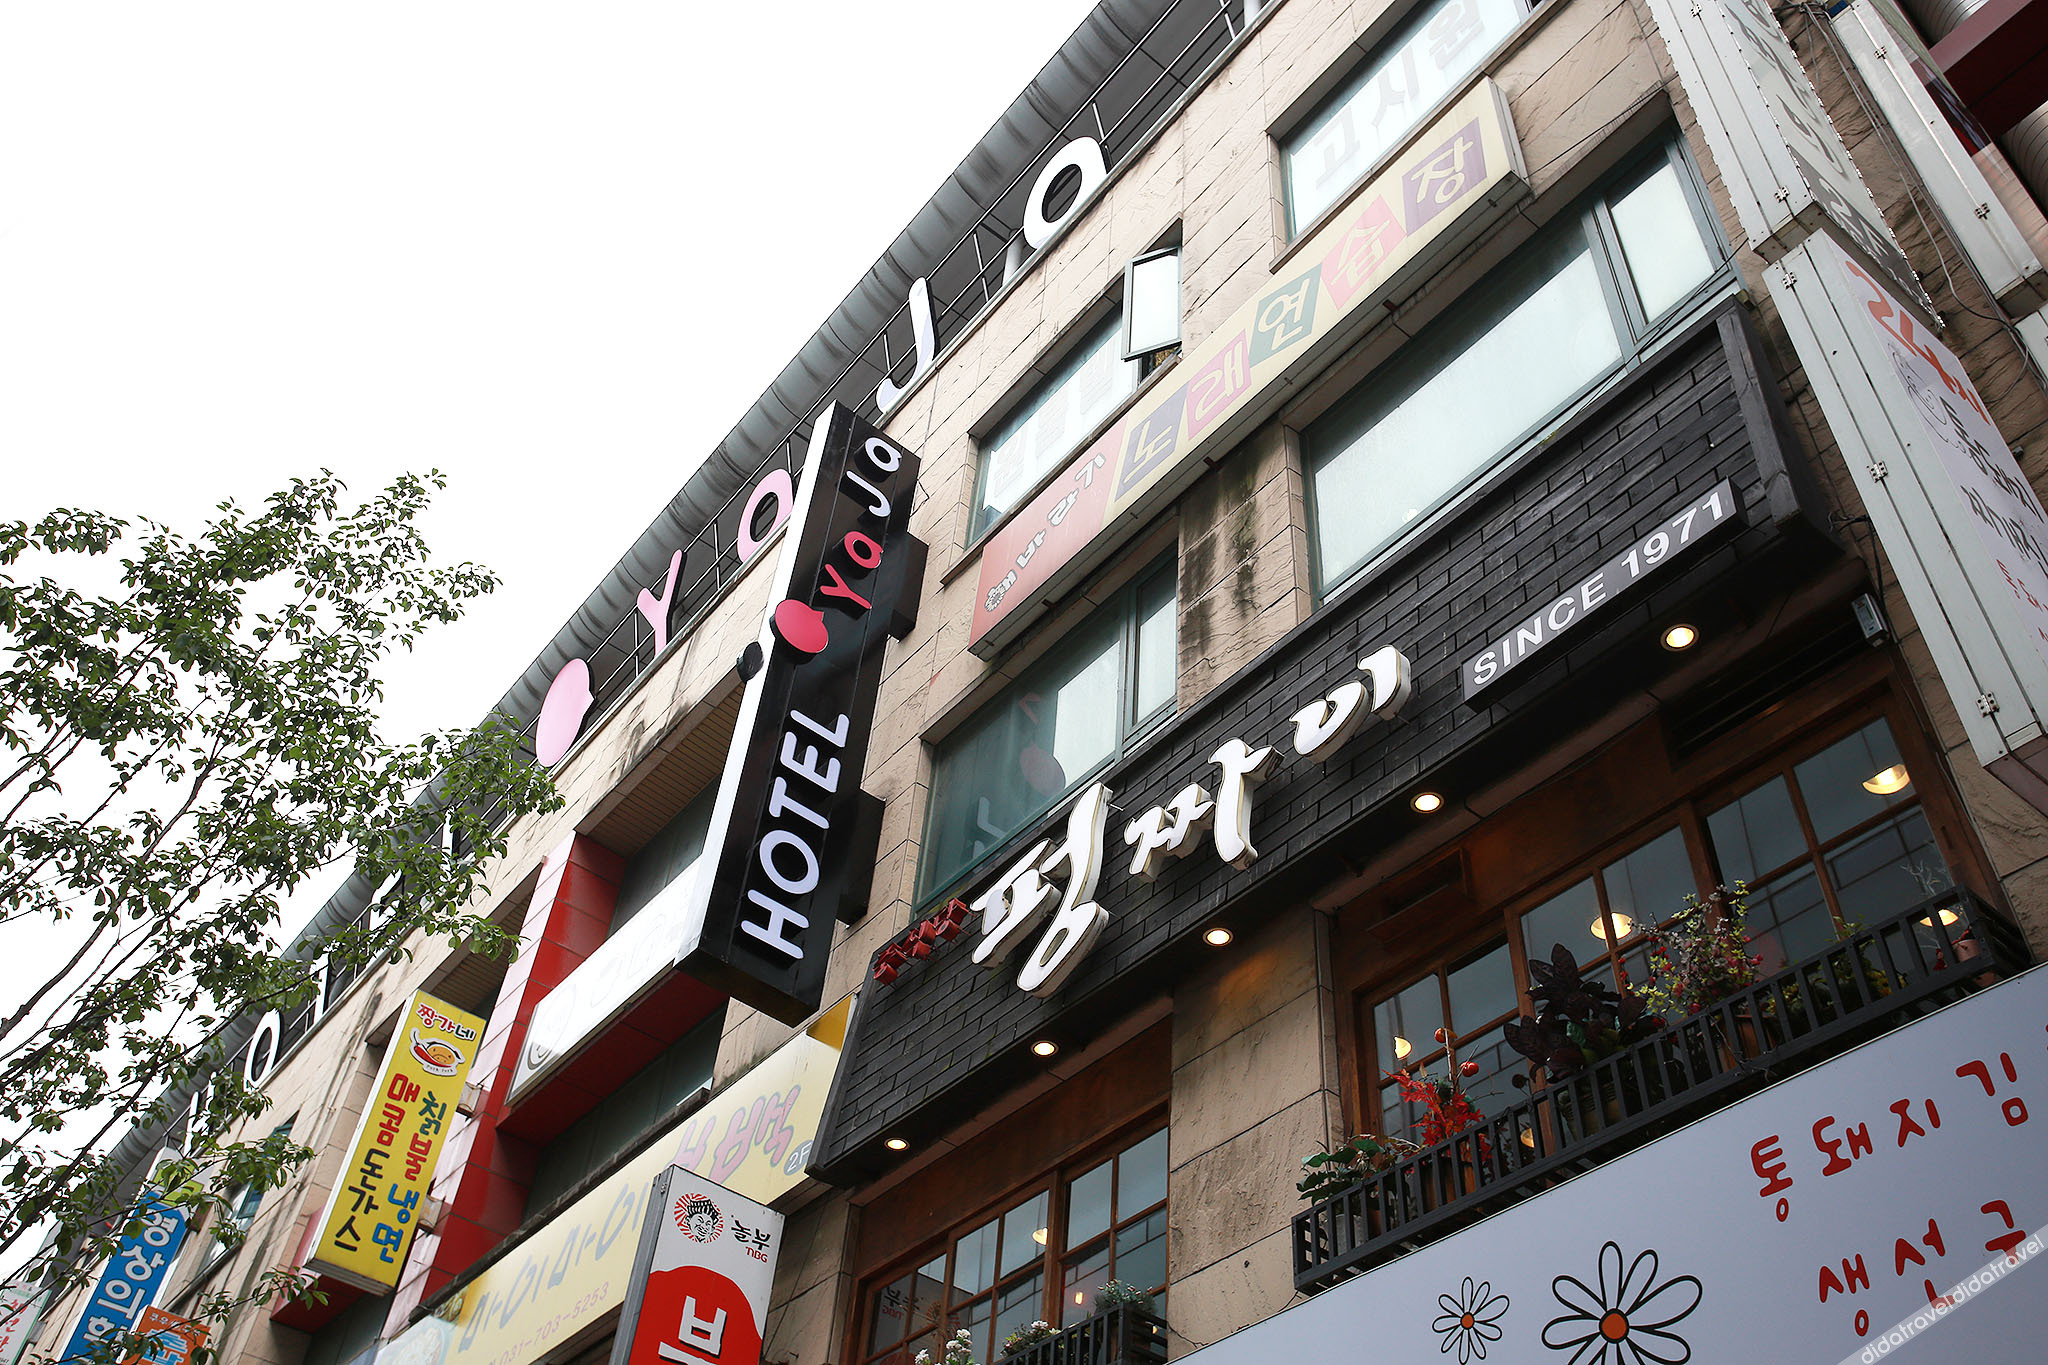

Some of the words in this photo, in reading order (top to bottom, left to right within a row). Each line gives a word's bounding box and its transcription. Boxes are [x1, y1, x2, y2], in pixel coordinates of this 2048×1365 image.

[983, 452, 1106, 614] 해바라기
[1121, 137, 1481, 486] 노래연습장
[1473, 572, 1607, 686] SINCE
[1621, 491, 1724, 579] 1971
[1996, 559, 2048, 612] 통돼
[741, 709, 850, 960] HOTEL
[1751, 1023, 2048, 1223] 통돼지김
[730, 1218, 771, 1251] 놀부
